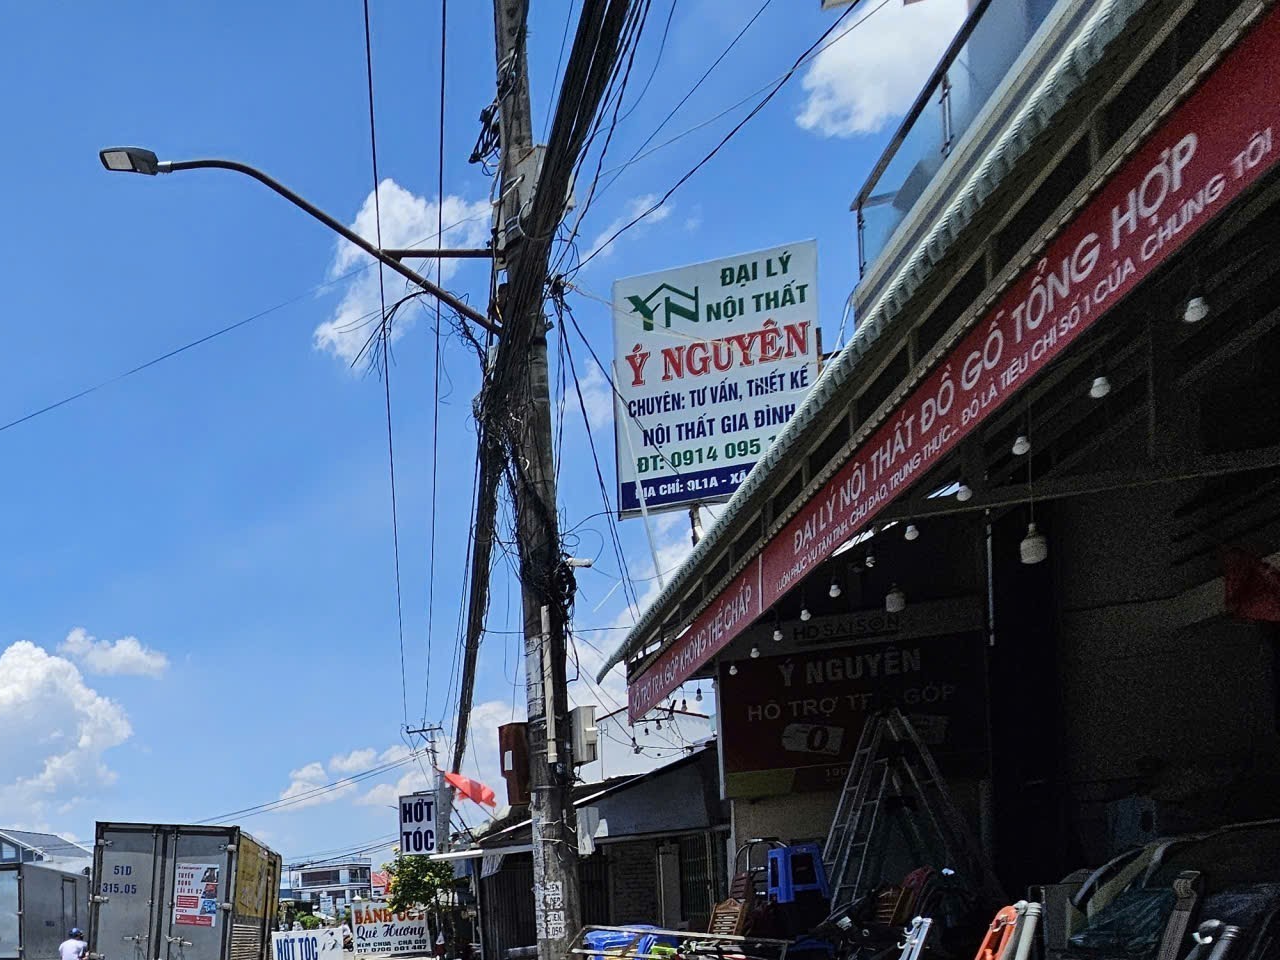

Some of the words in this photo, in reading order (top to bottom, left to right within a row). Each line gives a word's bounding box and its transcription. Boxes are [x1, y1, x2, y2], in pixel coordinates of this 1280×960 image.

[720, 261, 758, 288] ĐẠI
[767, 250, 792, 277] LÝ
[706, 296, 745, 324] NỘI
[751, 280, 809, 313] THẤT
[794, 513, 817, 555] ĐẠI
[820, 485, 838, 532] LÝ
[839, 461, 866, 513] NỘI
[870, 410, 916, 481] THẤT
[920, 363, 955, 435] ĐỒ
[1011, 233, 1102, 345] TỔNG
[1111, 132, 1198, 251] HỢP
[889, 452, 921, 489] TRUNG
[961, 392, 980, 427] ĐÓ
[980, 377, 999, 408] LÀ
[1000, 354, 1029, 390] TIÊU
[1058, 292, 1080, 338] SỐ
[1093, 256, 1137, 304] CỦA
[1140, 173, 1227, 263] CHÚNG
[625, 342, 651, 387] Ý
[661, 319, 812, 382] NGUYÊN
[628, 391, 686, 418] CHUYÊN:
[689, 385, 710, 409] TƯ
[710, 377, 743, 406] VẤN,
[746, 370, 786, 398] THIẾT
[790, 362, 810, 389] KẾ
[642, 424, 671, 449] NỘI
[676, 412, 716, 442] THẤT
[721, 413, 750, 434] GIA
[754, 402, 796, 429] ĐÌNH
[637, 454, 665, 474] ĐT:
[670, 446, 718, 469] 0914
[725, 437, 761, 460] 095
[659, 478, 684, 497] CHỈ:
[679, 628, 707, 672] KHÔNG
[724, 577, 752, 631] CHẤP
[402, 798, 434, 824] HỚT
[402, 826, 435, 852] TÓC
[102, 882, 137, 895] 315.05
[113, 865, 132, 876] 51D
[354, 904, 393, 925] BÁNH
[356, 925, 379, 941] Quê
[382, 923, 425, 938] Hương
